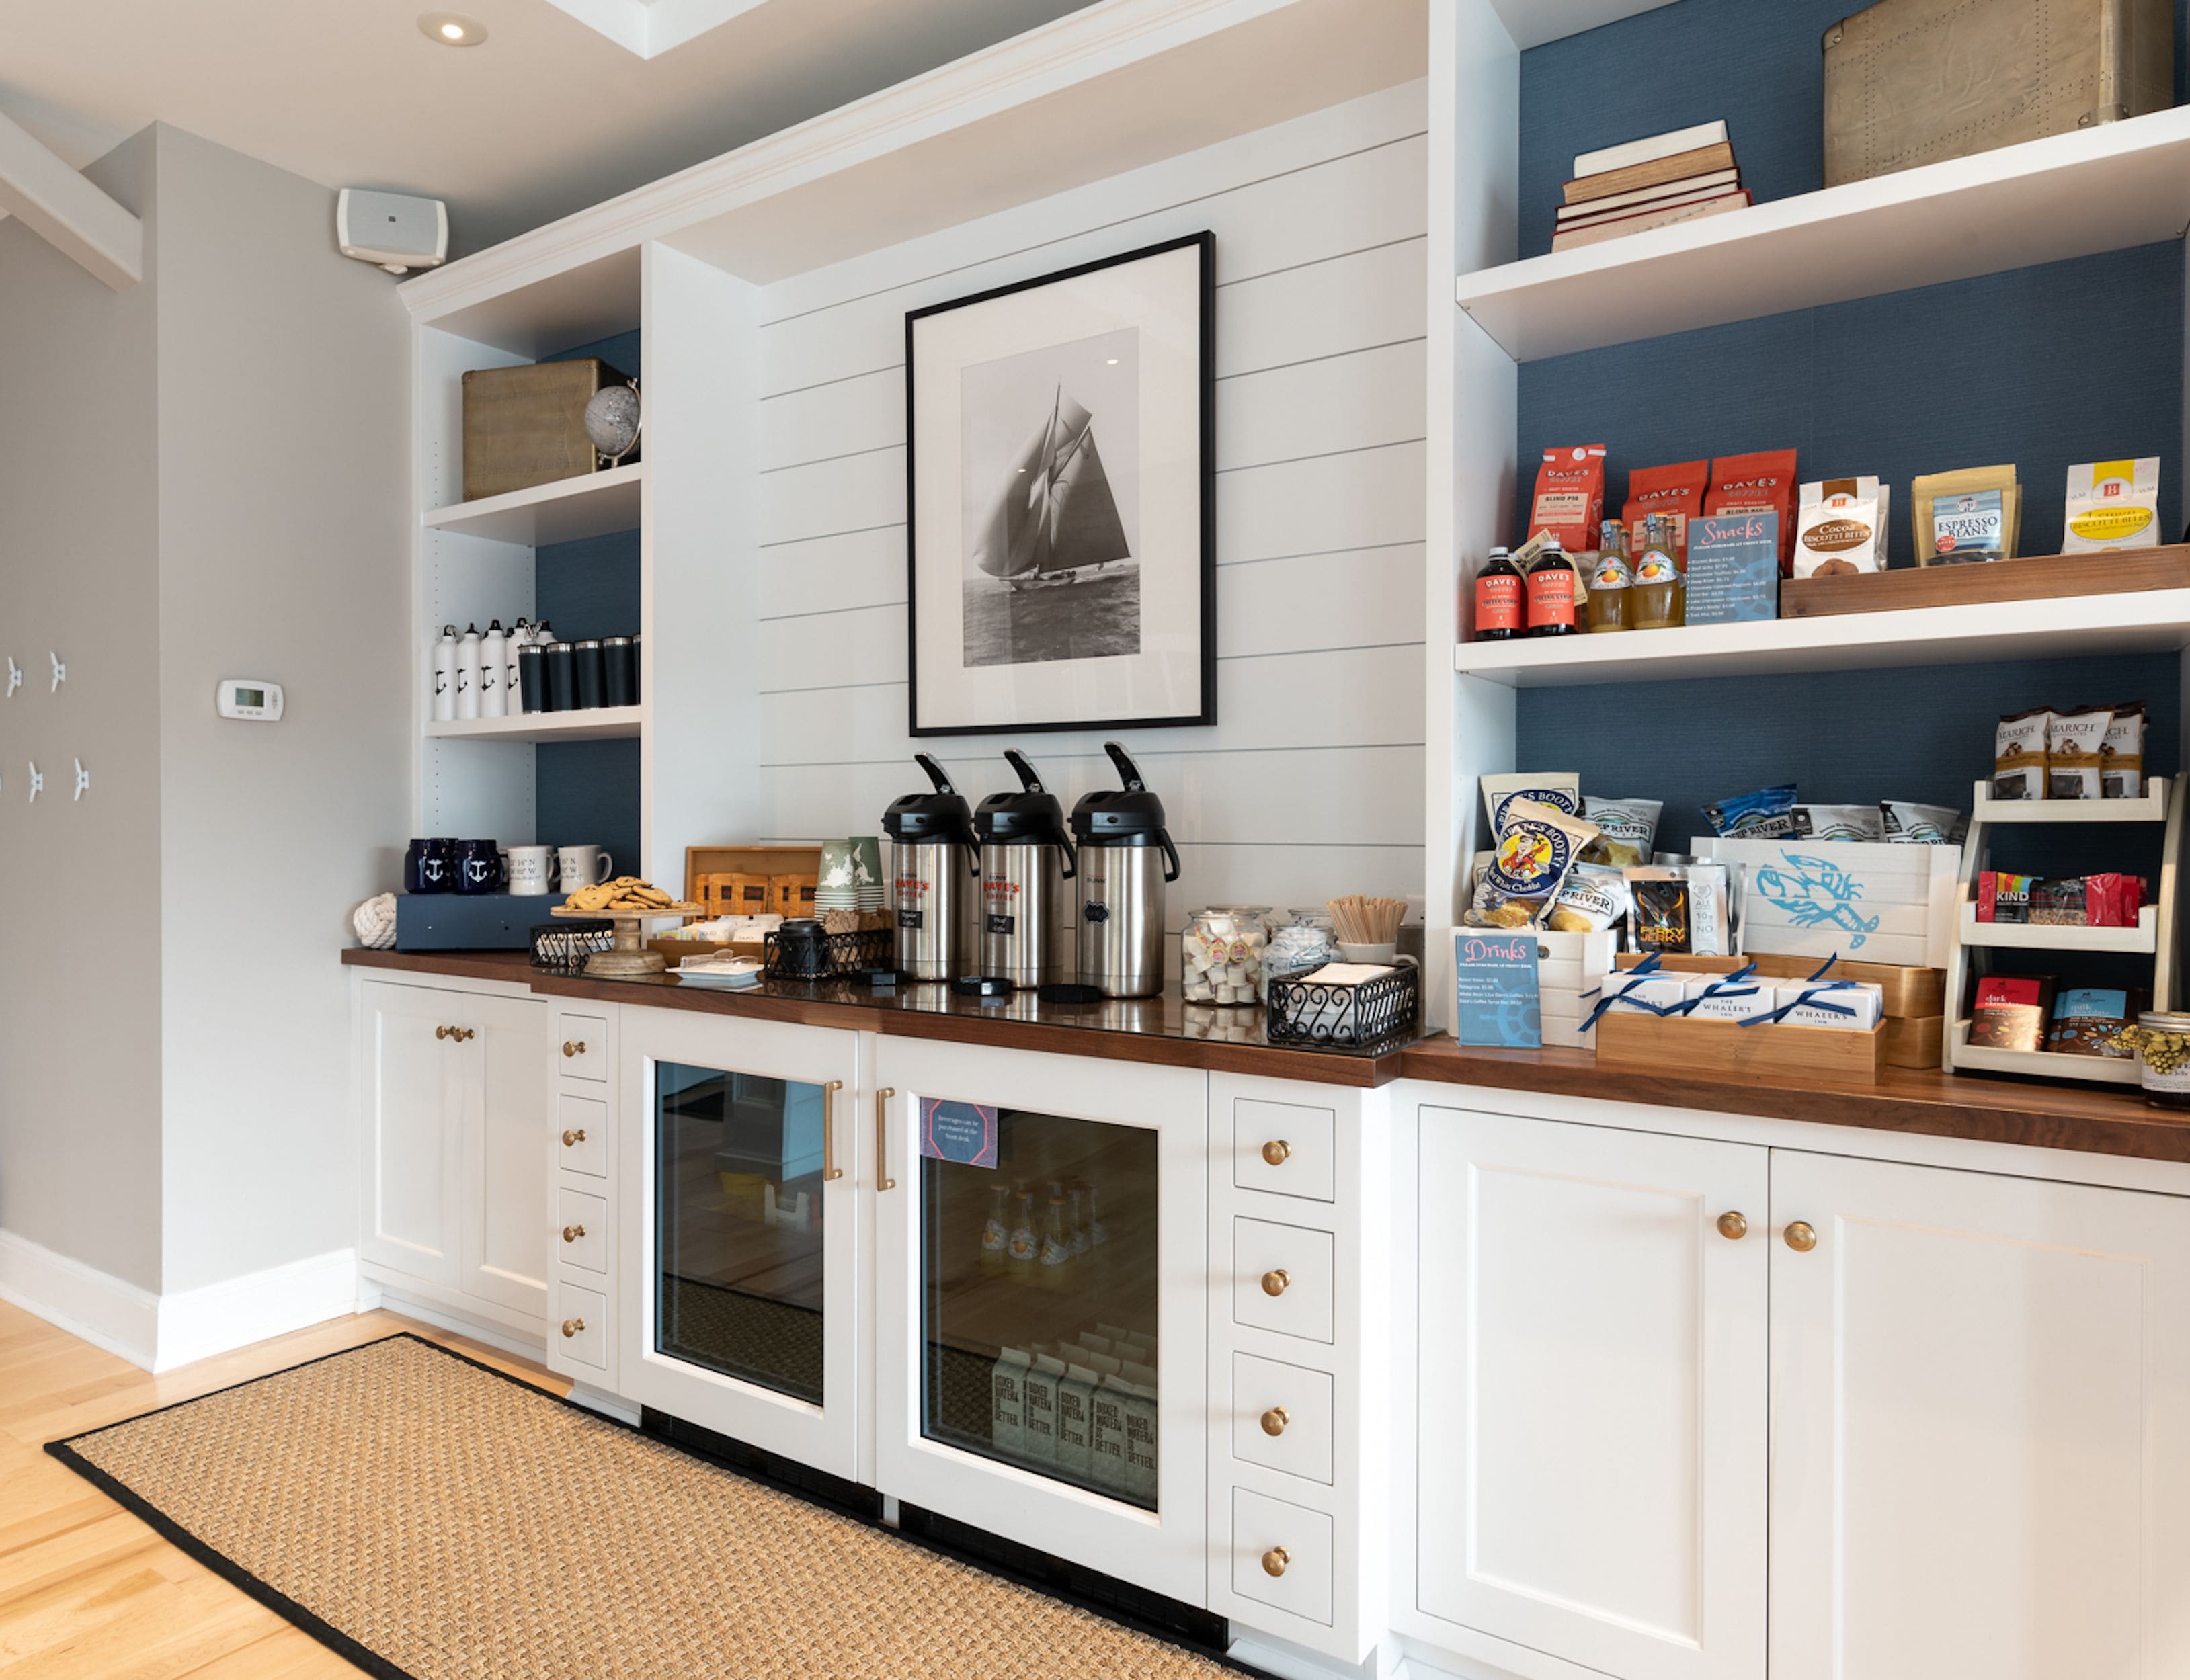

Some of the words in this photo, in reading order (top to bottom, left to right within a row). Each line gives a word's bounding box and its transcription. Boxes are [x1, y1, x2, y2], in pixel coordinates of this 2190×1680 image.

[1547, 469, 1589, 477] DAVE'S
[1722, 478, 1777, 491] DAVE'S
[1638, 488, 1690, 501] DAVE'S
[1727, 489, 1768, 497] COFFEE
[1642, 498, 1678, 509] COFFEE
[1938, 516, 1998, 532] ESPRESSO
[1701, 516, 1763, 545] Snacks
[1819, 525, 1855, 535] Cocoa
[1949, 525, 1988, 537] BEANS
[1803, 532, 1843, 542] BISCOTTI
[1486, 579, 1516, 587] DAVE'S
[1537, 573, 1570, 583] DAVE'S
[1998, 725, 2035, 739] MARICH
[2050, 724, 2095, 733] MARICH
[1611, 824, 1648, 837] RIVER
[1749, 818, 1789, 834] RIVER
[895, 878, 929, 891] DAVE'S
[984, 881, 1020, 893] DAVE'S
[987, 892, 1014, 901] COFFEE
[1570, 891, 1610, 911] RIVER
[1996, 891, 2029, 902] KIND
[1640, 927, 1685, 935] PERKY
[1696, 925, 1713, 933] NO
[1640, 934, 1685, 943] JERKY
[1465, 938, 1527, 962] Drinks
[1703, 1003, 1752, 1013] WHALER'S
[1795, 1010, 1848, 1020] WHALER'S
